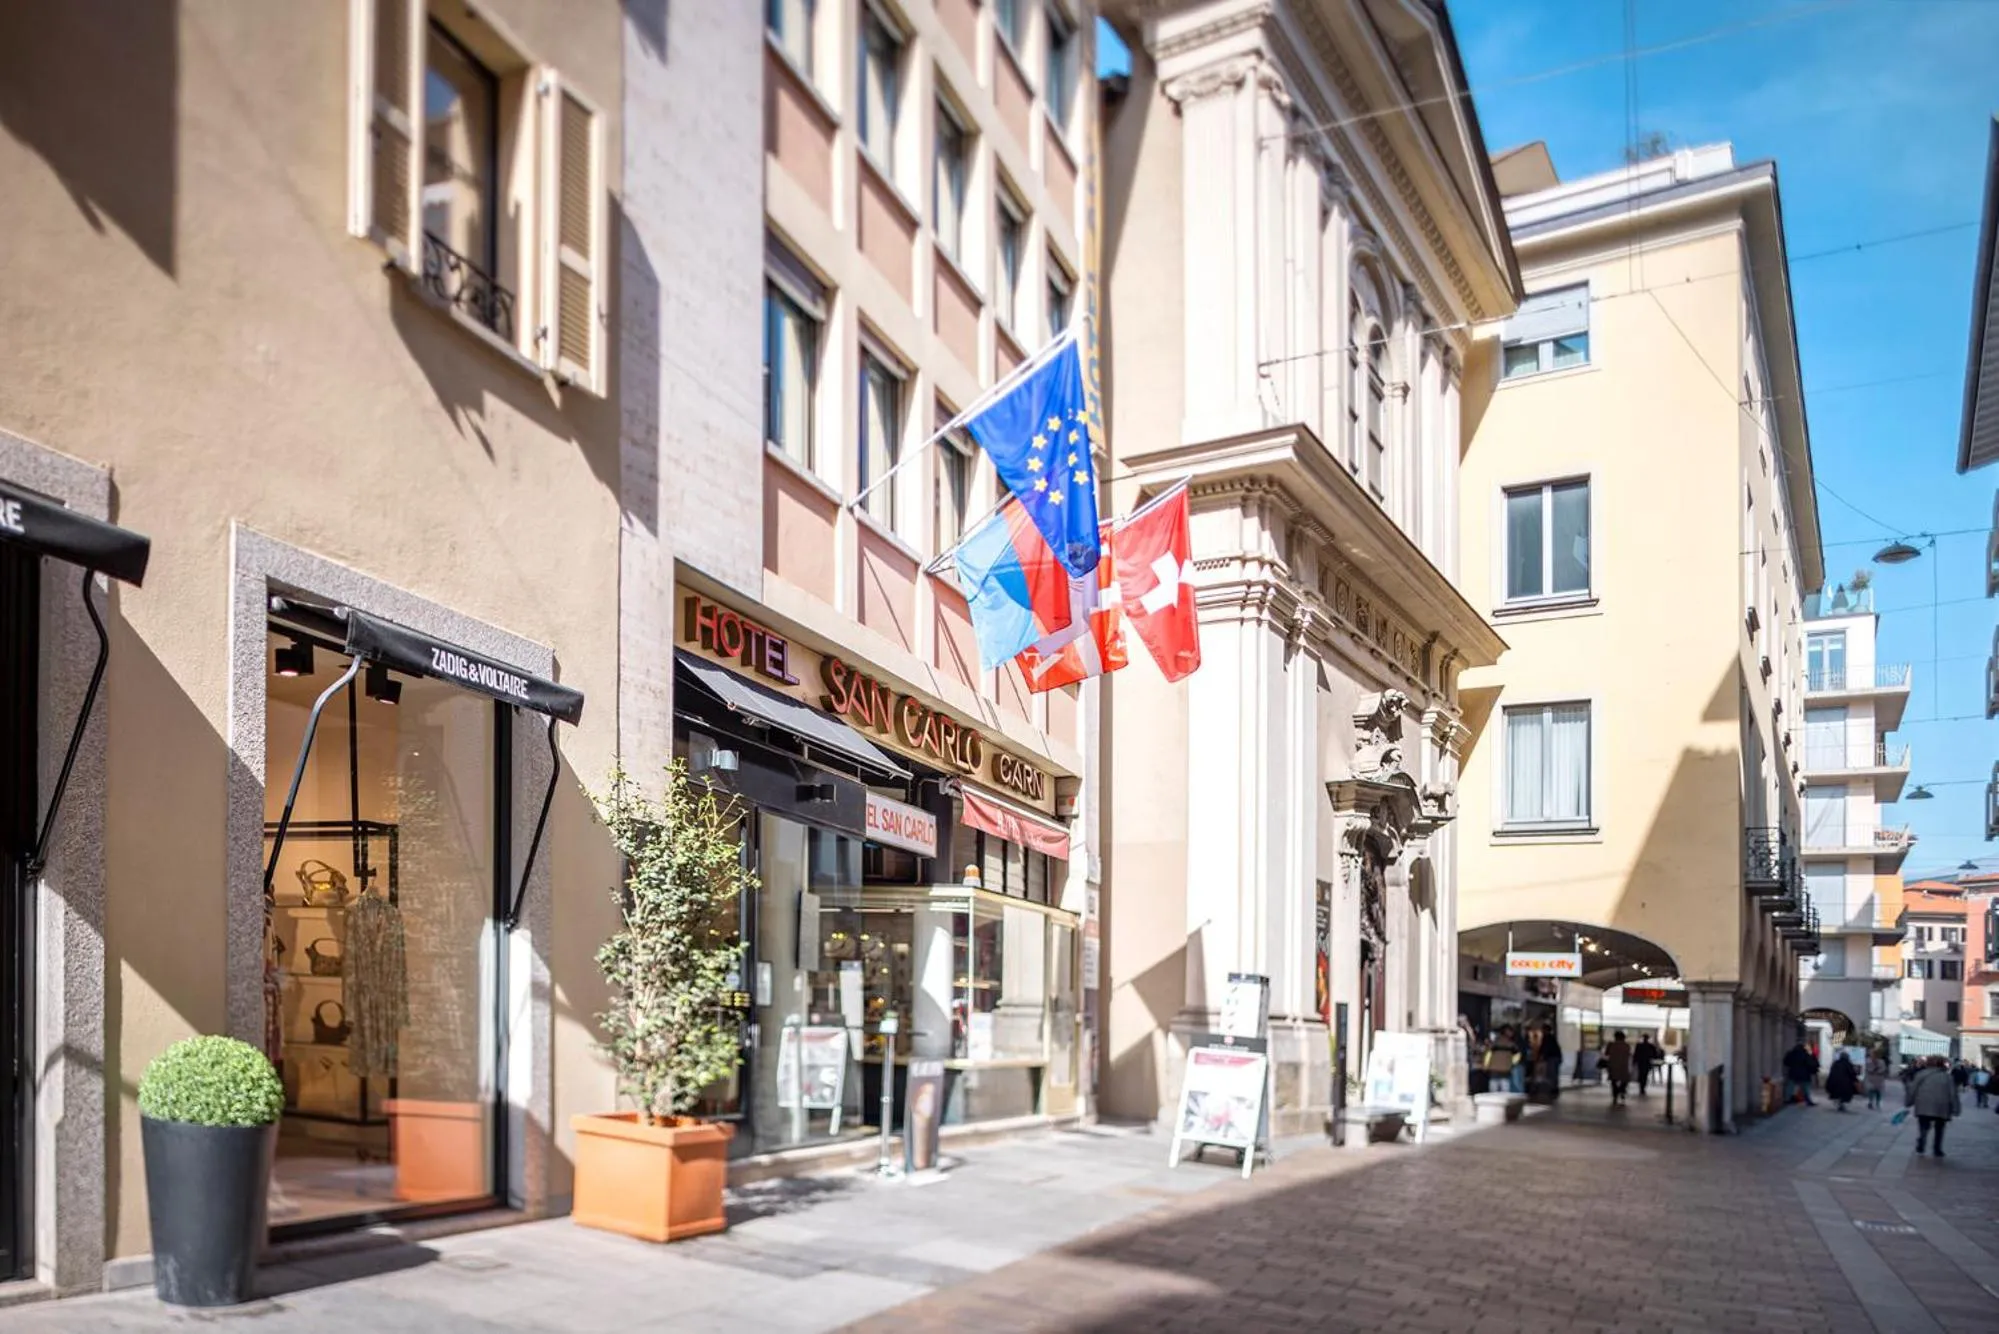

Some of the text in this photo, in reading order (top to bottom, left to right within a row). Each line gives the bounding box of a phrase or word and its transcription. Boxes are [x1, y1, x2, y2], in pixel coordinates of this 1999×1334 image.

[687, 596, 800, 685] HOTEL
[822, 657, 892, 735] SAN
[896, 695, 983, 775] CARLO
[881, 808, 902, 836] SAN
[905, 815, 936, 846] CARLO
